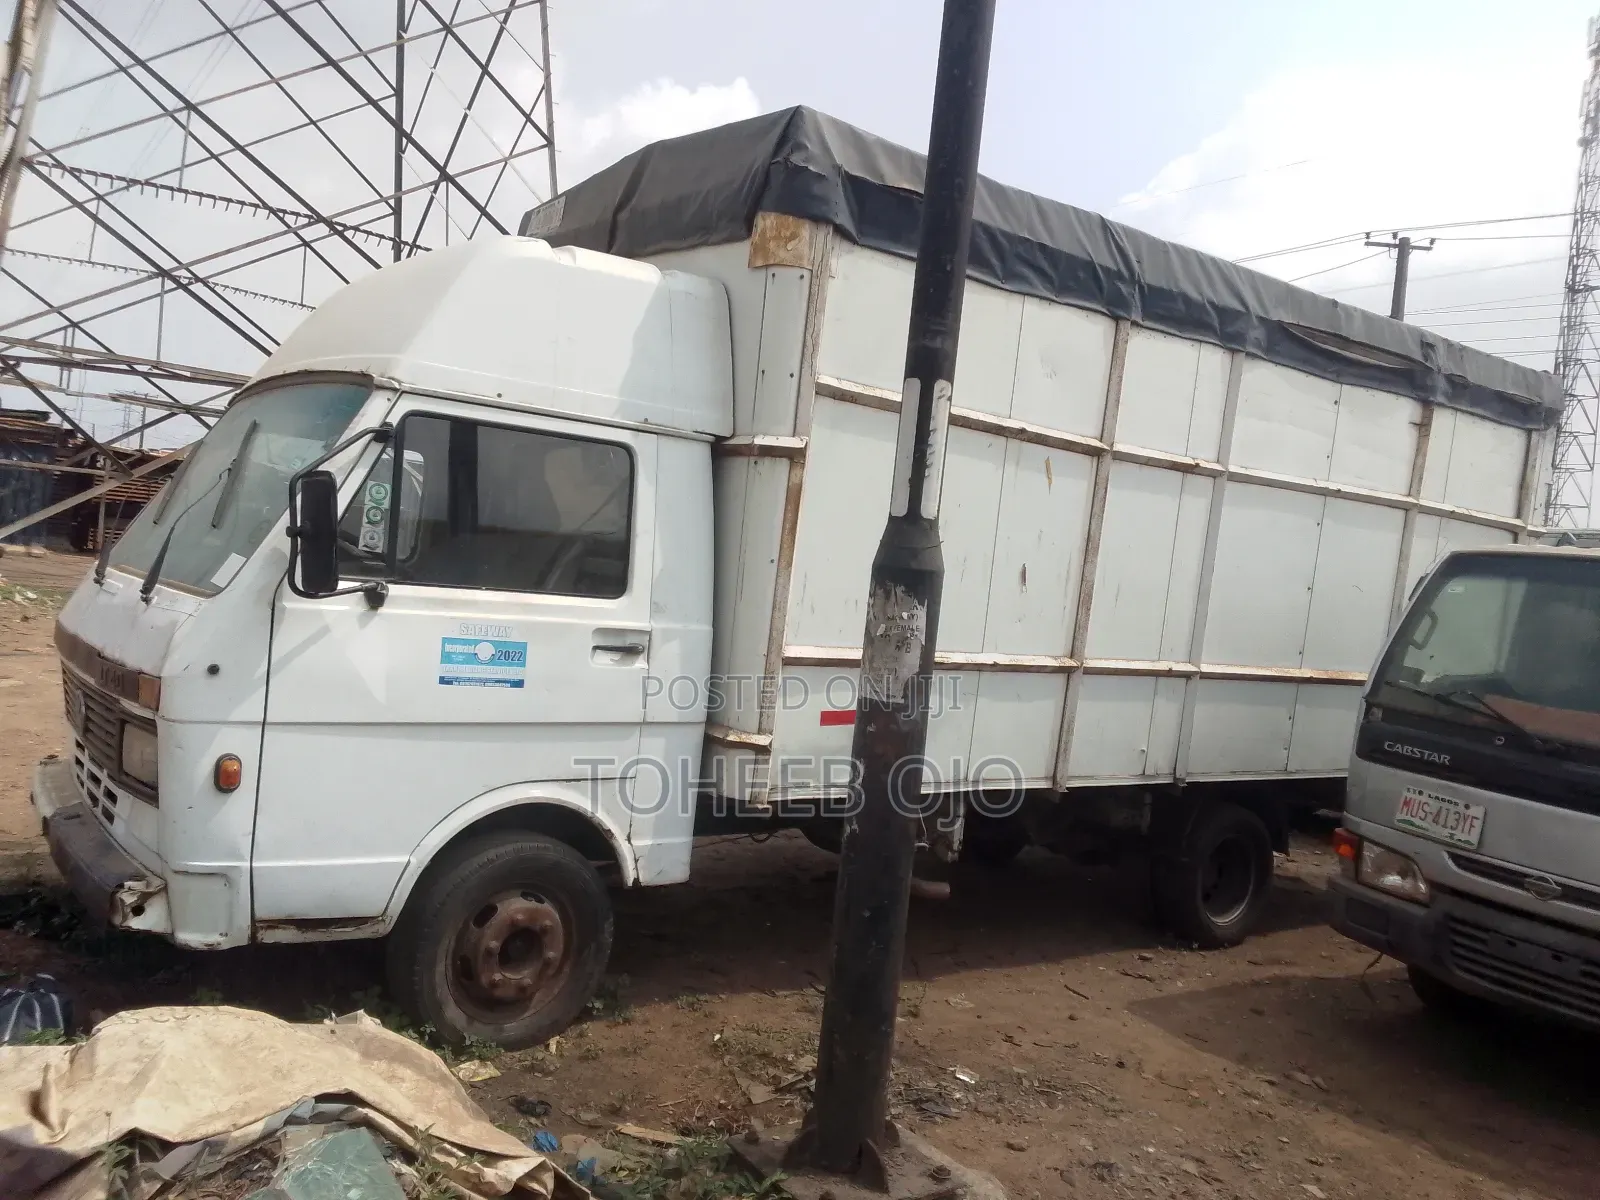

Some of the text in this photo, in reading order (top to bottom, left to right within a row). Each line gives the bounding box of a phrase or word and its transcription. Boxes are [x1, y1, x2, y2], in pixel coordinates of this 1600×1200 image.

[460, 623, 513, 638] SAFEWAY
[496, 650, 523, 662] 2022
[1383, 740, 1451, 766] CABSTAR
[1427, 793, 1460, 807] LAGOS
[1400, 795, 1480, 836] MUS-413YF
